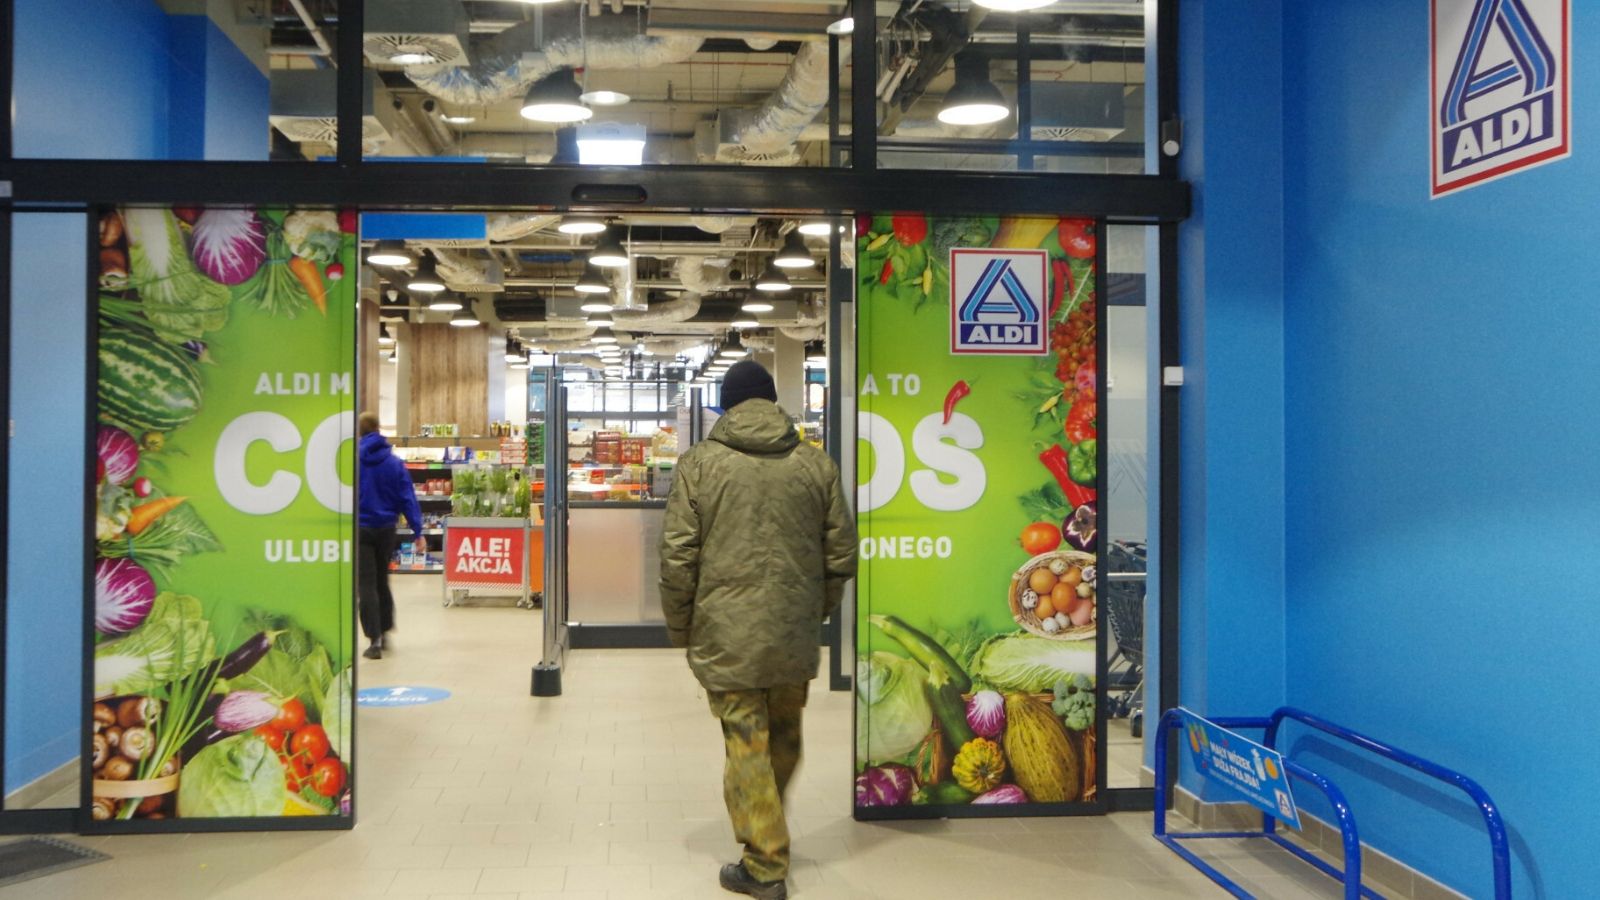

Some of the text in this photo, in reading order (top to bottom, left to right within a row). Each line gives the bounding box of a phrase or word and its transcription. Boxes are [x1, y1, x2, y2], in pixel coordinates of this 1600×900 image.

[1451, 99, 1544, 167] ALDI
[967, 325, 1033, 343] ALDI
[254, 372, 321, 395] ALDI
[887, 373, 921, 396] TO
[264, 539, 350, 563] ULUBI
[457, 536, 511, 558] ALE!
[859, 535, 952, 560] ONEGO
[455, 557, 513, 574] AKCJA
